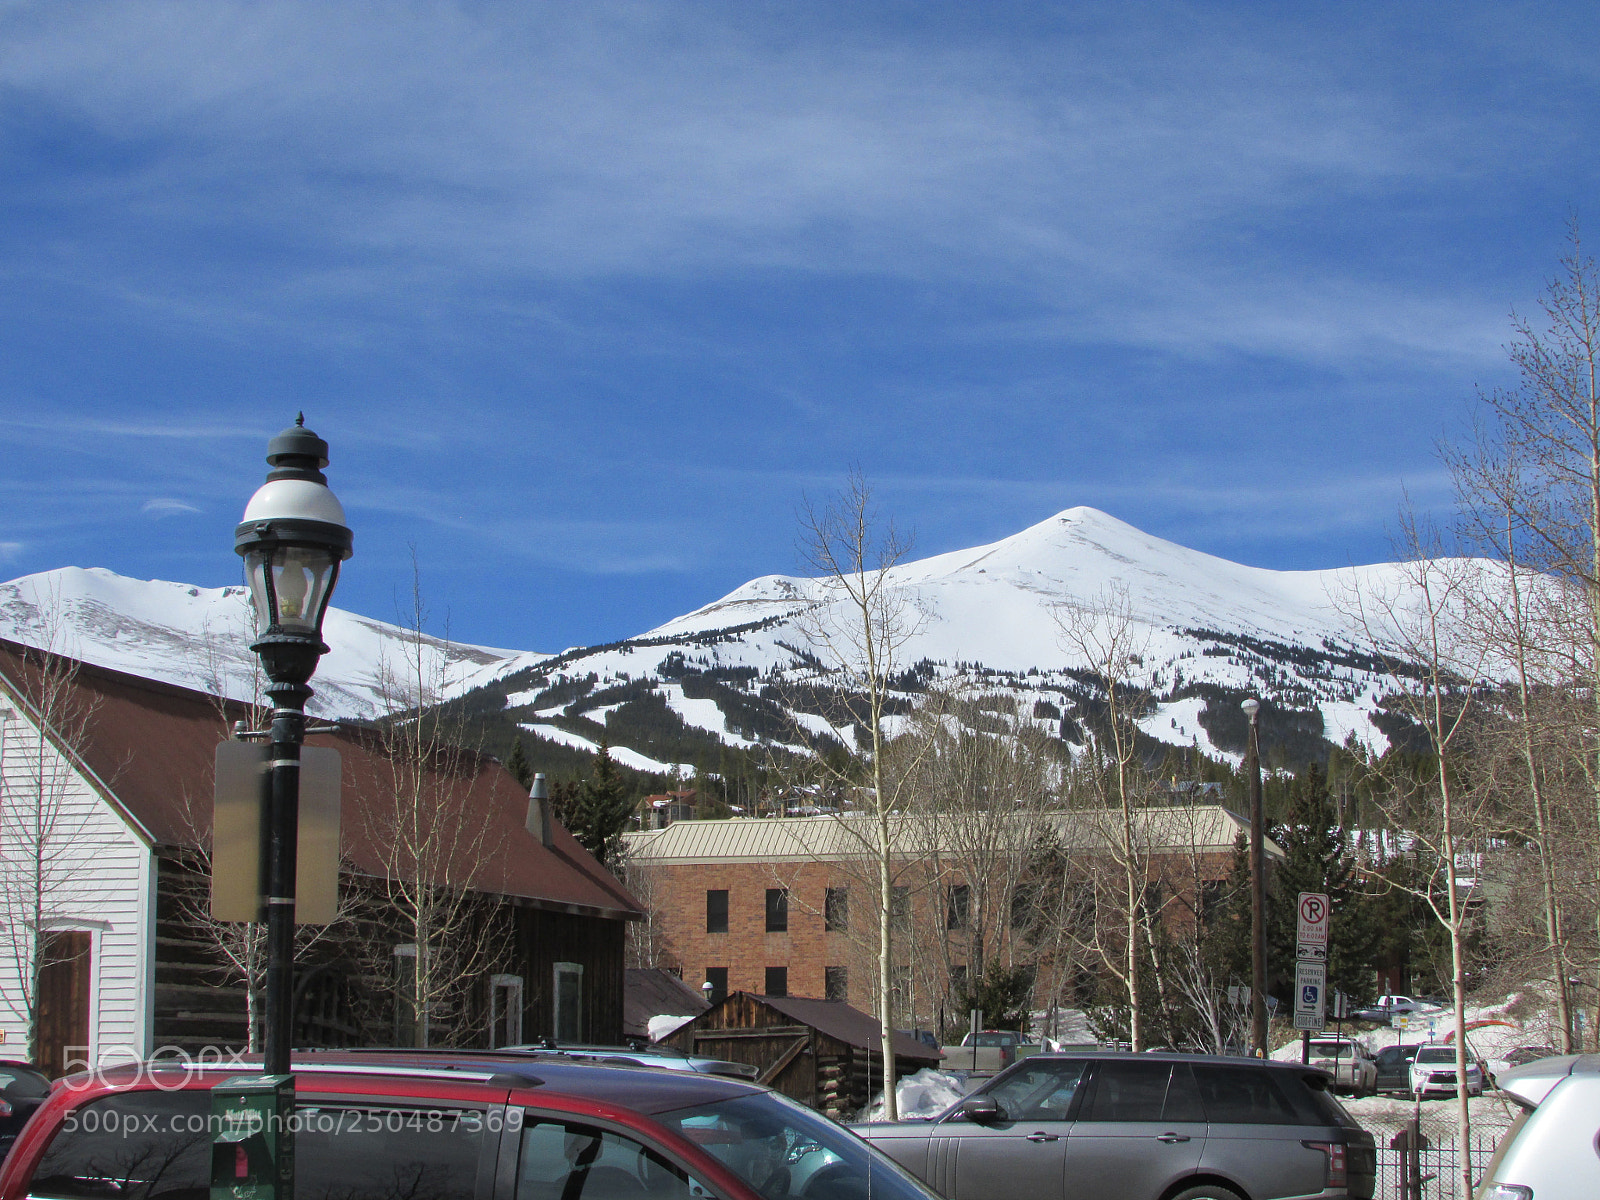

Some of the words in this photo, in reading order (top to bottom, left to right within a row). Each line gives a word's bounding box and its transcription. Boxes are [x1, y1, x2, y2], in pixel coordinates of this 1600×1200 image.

[1309, 901, 1320, 919] P
[1299, 968, 1323, 977] RESERVED
[1308, 1017, 1322, 1027] FINE
